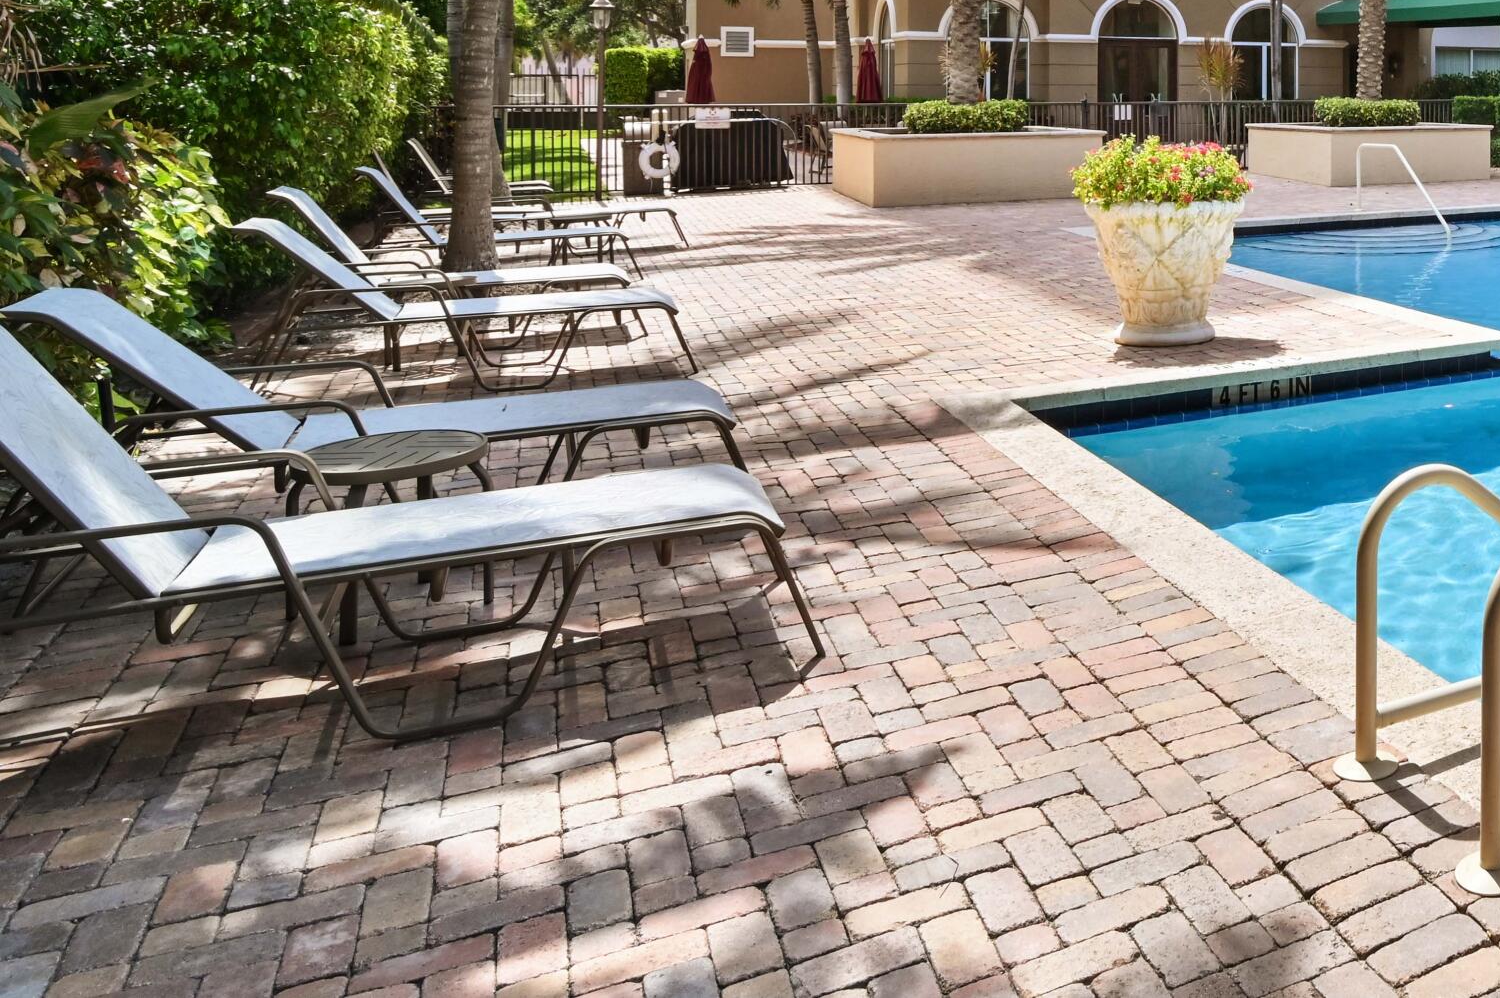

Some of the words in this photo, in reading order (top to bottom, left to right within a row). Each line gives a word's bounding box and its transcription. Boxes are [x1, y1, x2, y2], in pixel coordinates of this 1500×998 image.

[1219, 385, 1231, 405] 4
[1239, 381, 1263, 404] FT
[1270, 379, 1281, 400] 6
[1288, 375, 1311, 398] IN
